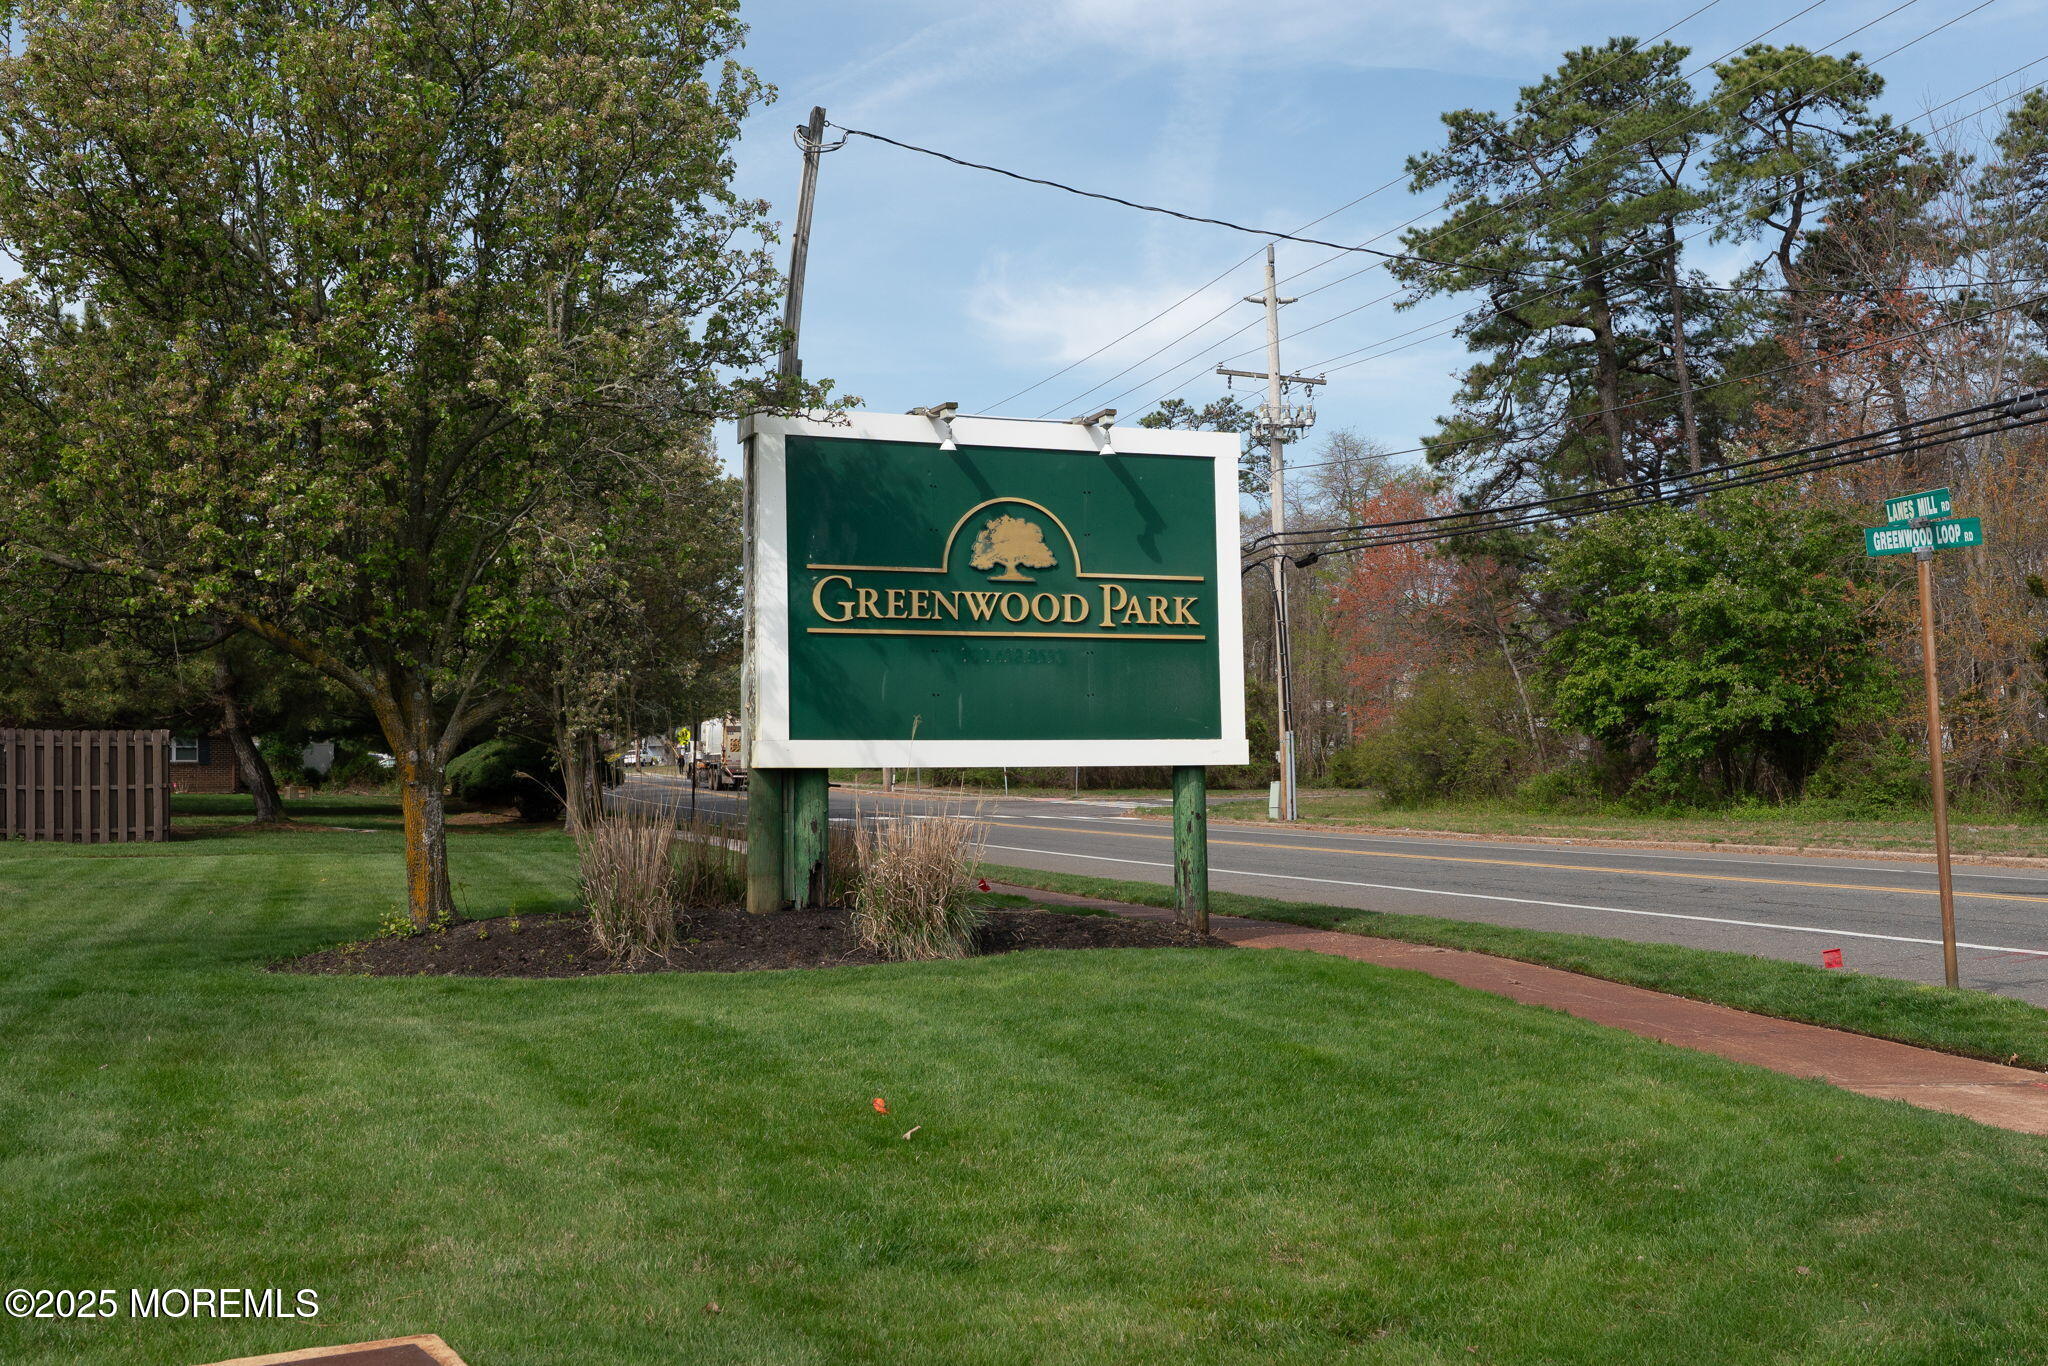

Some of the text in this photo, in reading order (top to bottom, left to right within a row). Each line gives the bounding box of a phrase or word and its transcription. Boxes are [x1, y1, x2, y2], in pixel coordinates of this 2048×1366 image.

[1886, 496, 1950, 523] LANES MILL RD
[1873, 524, 1974, 551] GREENWOOD LOOP RD
[811, 575, 1201, 628] GREENWOOD PARK
